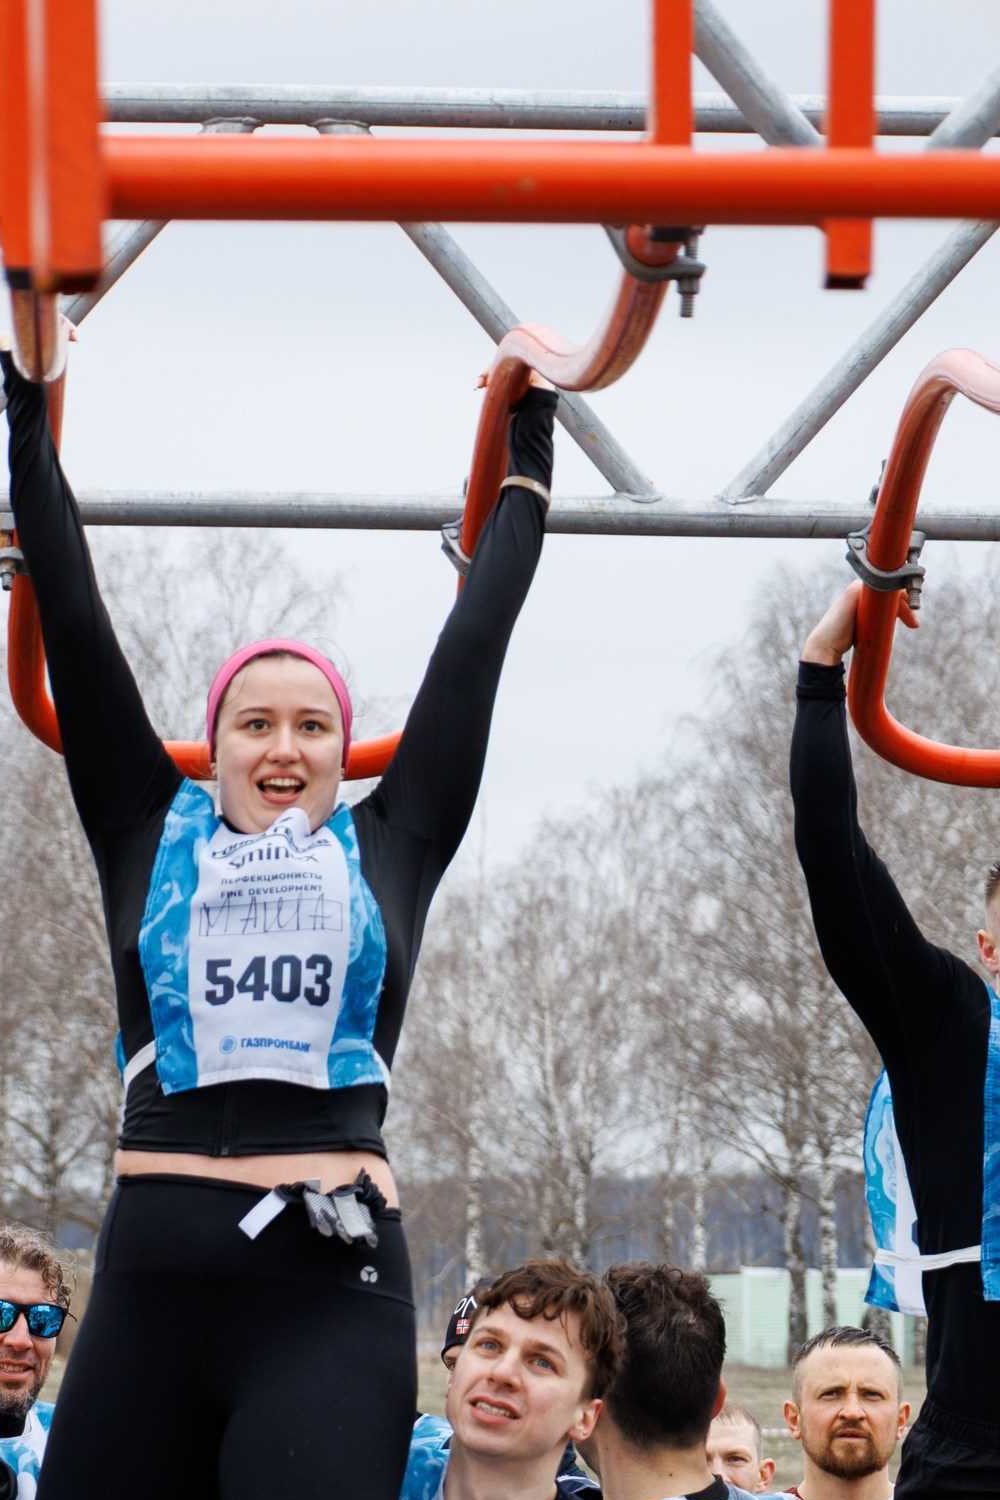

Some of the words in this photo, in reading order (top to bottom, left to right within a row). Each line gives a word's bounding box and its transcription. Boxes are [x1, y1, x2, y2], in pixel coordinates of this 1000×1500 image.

[220, 890, 244, 898] FINE
[248, 883, 323, 896] DEVELOPMENT
[205, 953, 333, 1007] 5403
[240, 1038, 312, 1053] ГАЗПРОМБАНК
